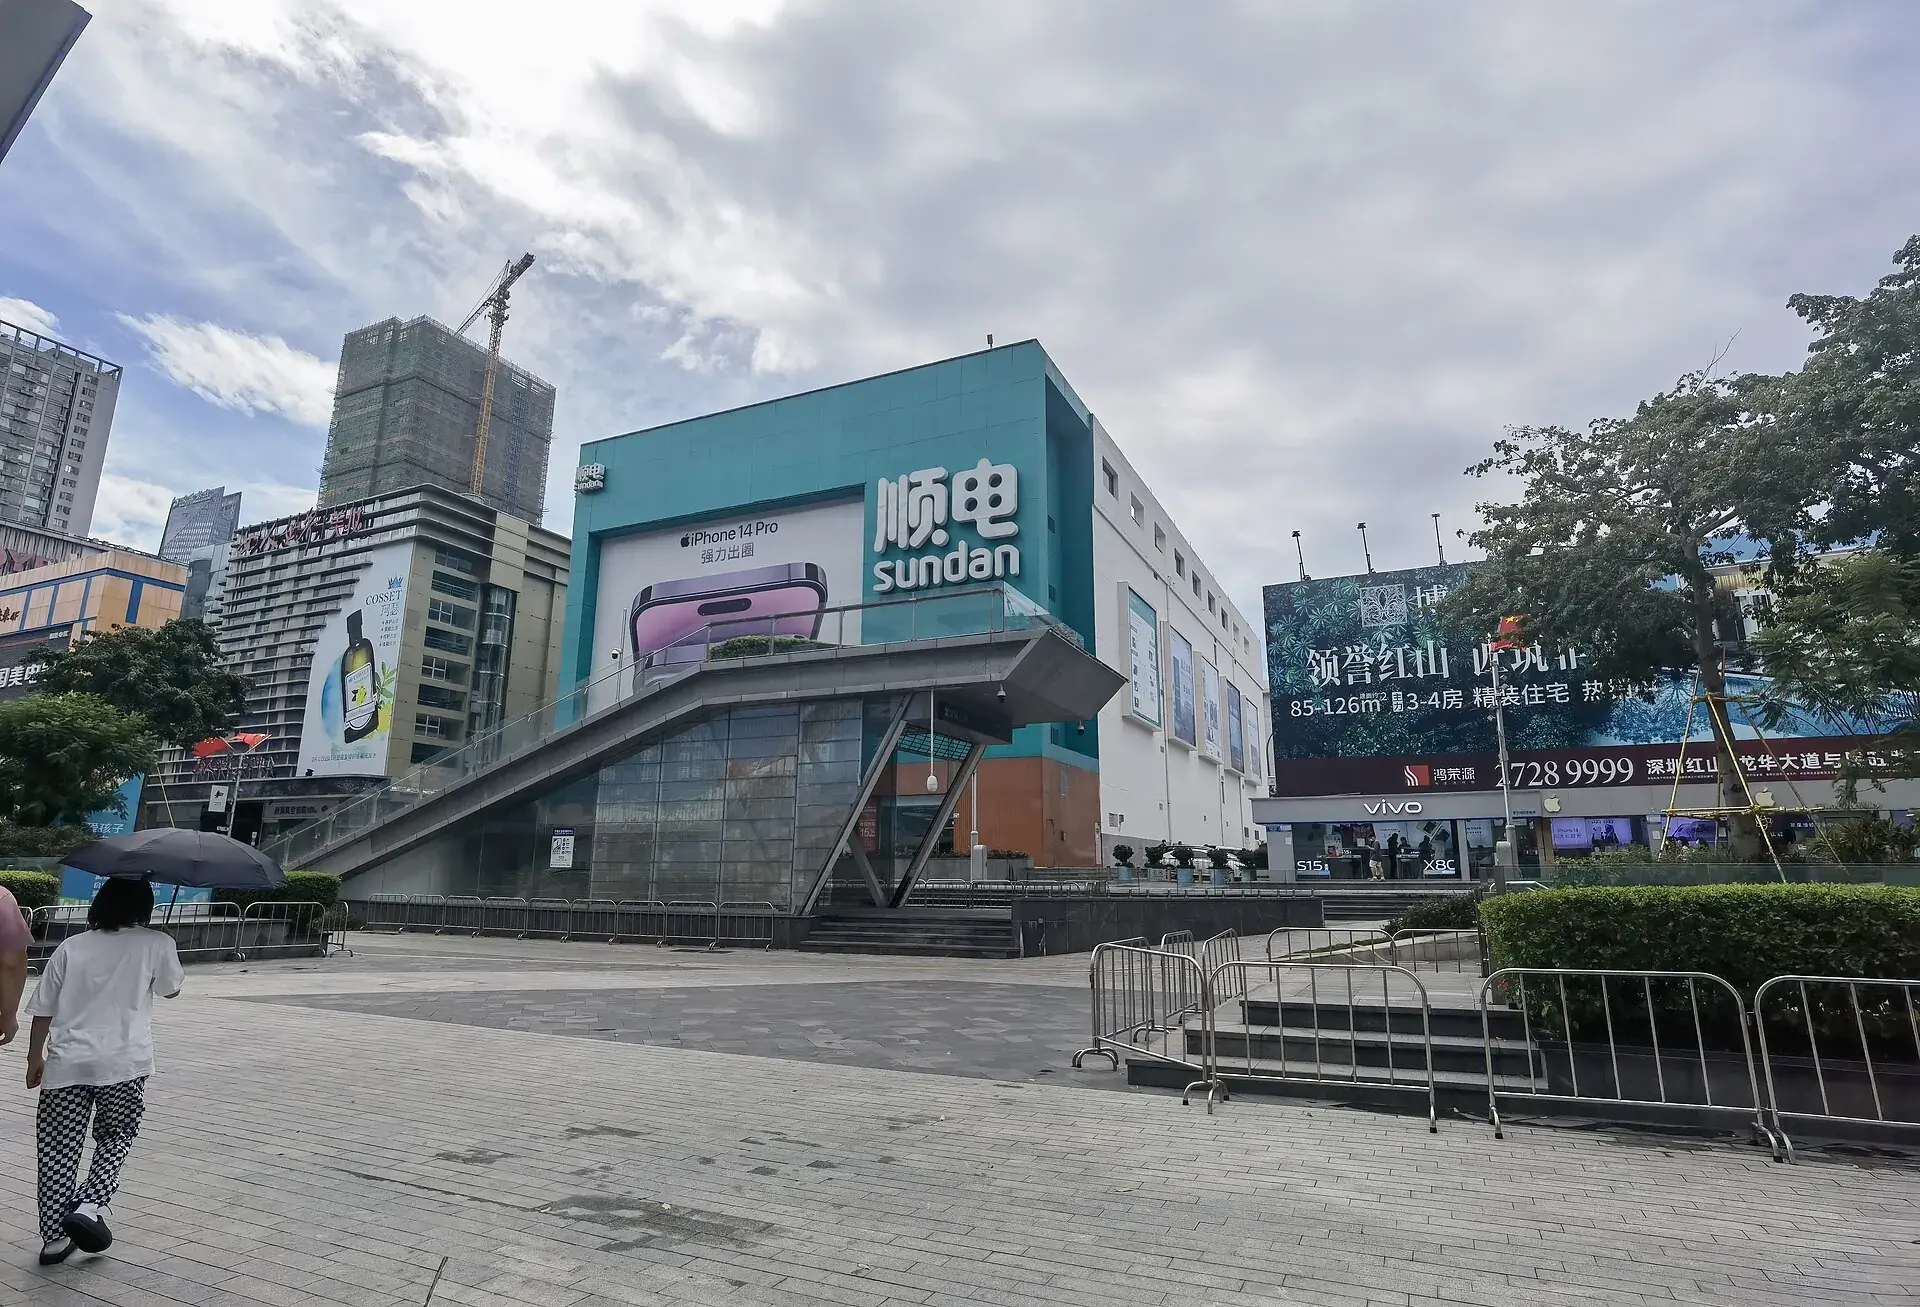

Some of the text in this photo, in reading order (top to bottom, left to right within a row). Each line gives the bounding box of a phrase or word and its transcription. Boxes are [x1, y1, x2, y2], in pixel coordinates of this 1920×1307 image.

[874, 457, 1018, 554] 顺电
[691, 521, 779, 547] iPhone 14 Pro
[701, 542, 754, 564] 强力出圈
[872, 540, 1020, 593] sundan
[365, 589, 403, 605] COSSET
[1306, 640, 1450, 688] 领誉红山
[1406, 689, 1463, 711] 3-4房
[1472, 681, 1570, 708] 精装住宅
[1433, 767, 1476, 781] 鸿荣源
[1494, 757, 1634, 787] 2728 9999
[1363, 798, 1423, 814] vivo
